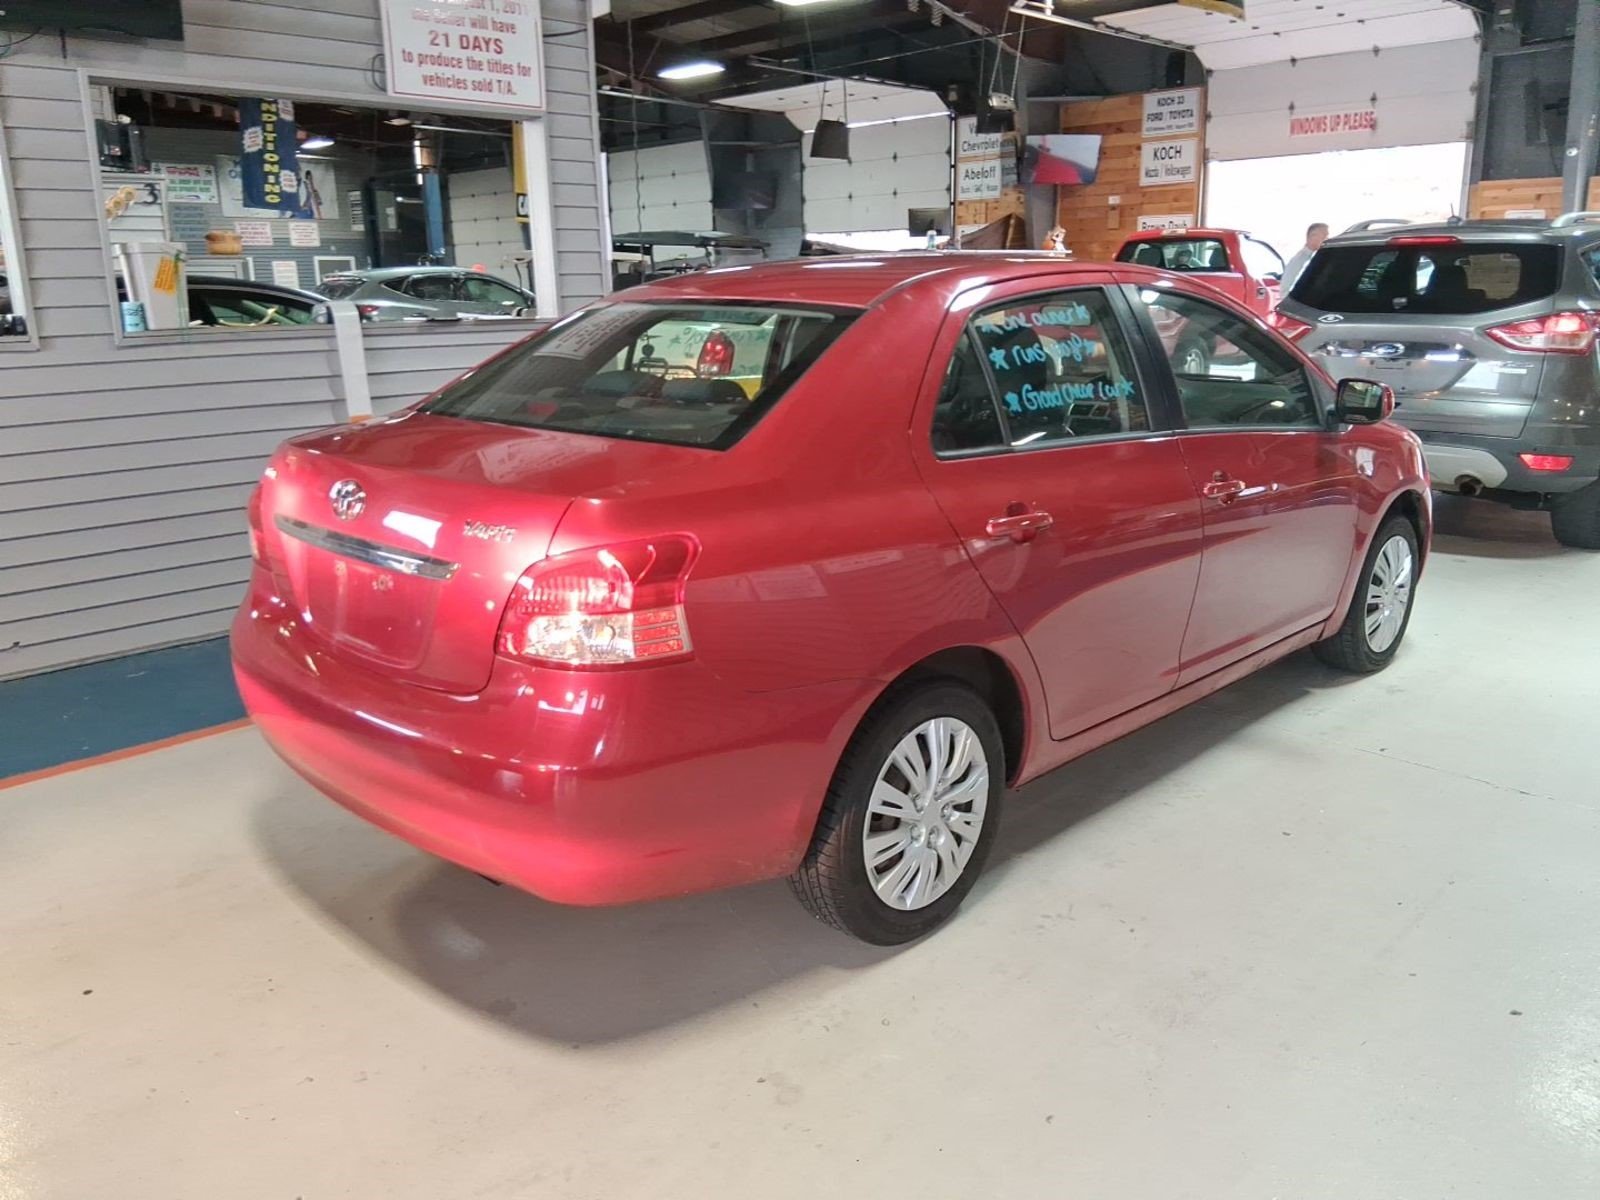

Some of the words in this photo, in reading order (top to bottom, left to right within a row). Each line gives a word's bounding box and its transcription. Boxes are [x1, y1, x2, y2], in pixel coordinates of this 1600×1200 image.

[469, 15, 488, 30] will
[491, 17, 517, 34] have
[428, 29, 450, 47] 21
[459, 34, 504, 54] DAYS
[402, 48, 414, 62] to
[417, 52, 463, 69] produce
[466, 56, 484, 71] the
[487, 59, 514, 75] titles
[517, 62, 532, 77] for
[421, 72, 469, 90] vehicles
[471, 77, 493, 93] sold
[1157, 96, 1176, 107] KOCH
[1169, 108, 1195, 120] TOYOTA
[1290, 115, 1328, 135] WINDOWS
[1329, 114, 1341, 132] UP
[1343, 111, 1376, 131] PLEASE
[1153, 145, 1183, 161] KOCH
[963, 166, 997, 181] Abeloff
[143, 183, 159, 205] 3
[1012, 343, 1046, 366] runs
